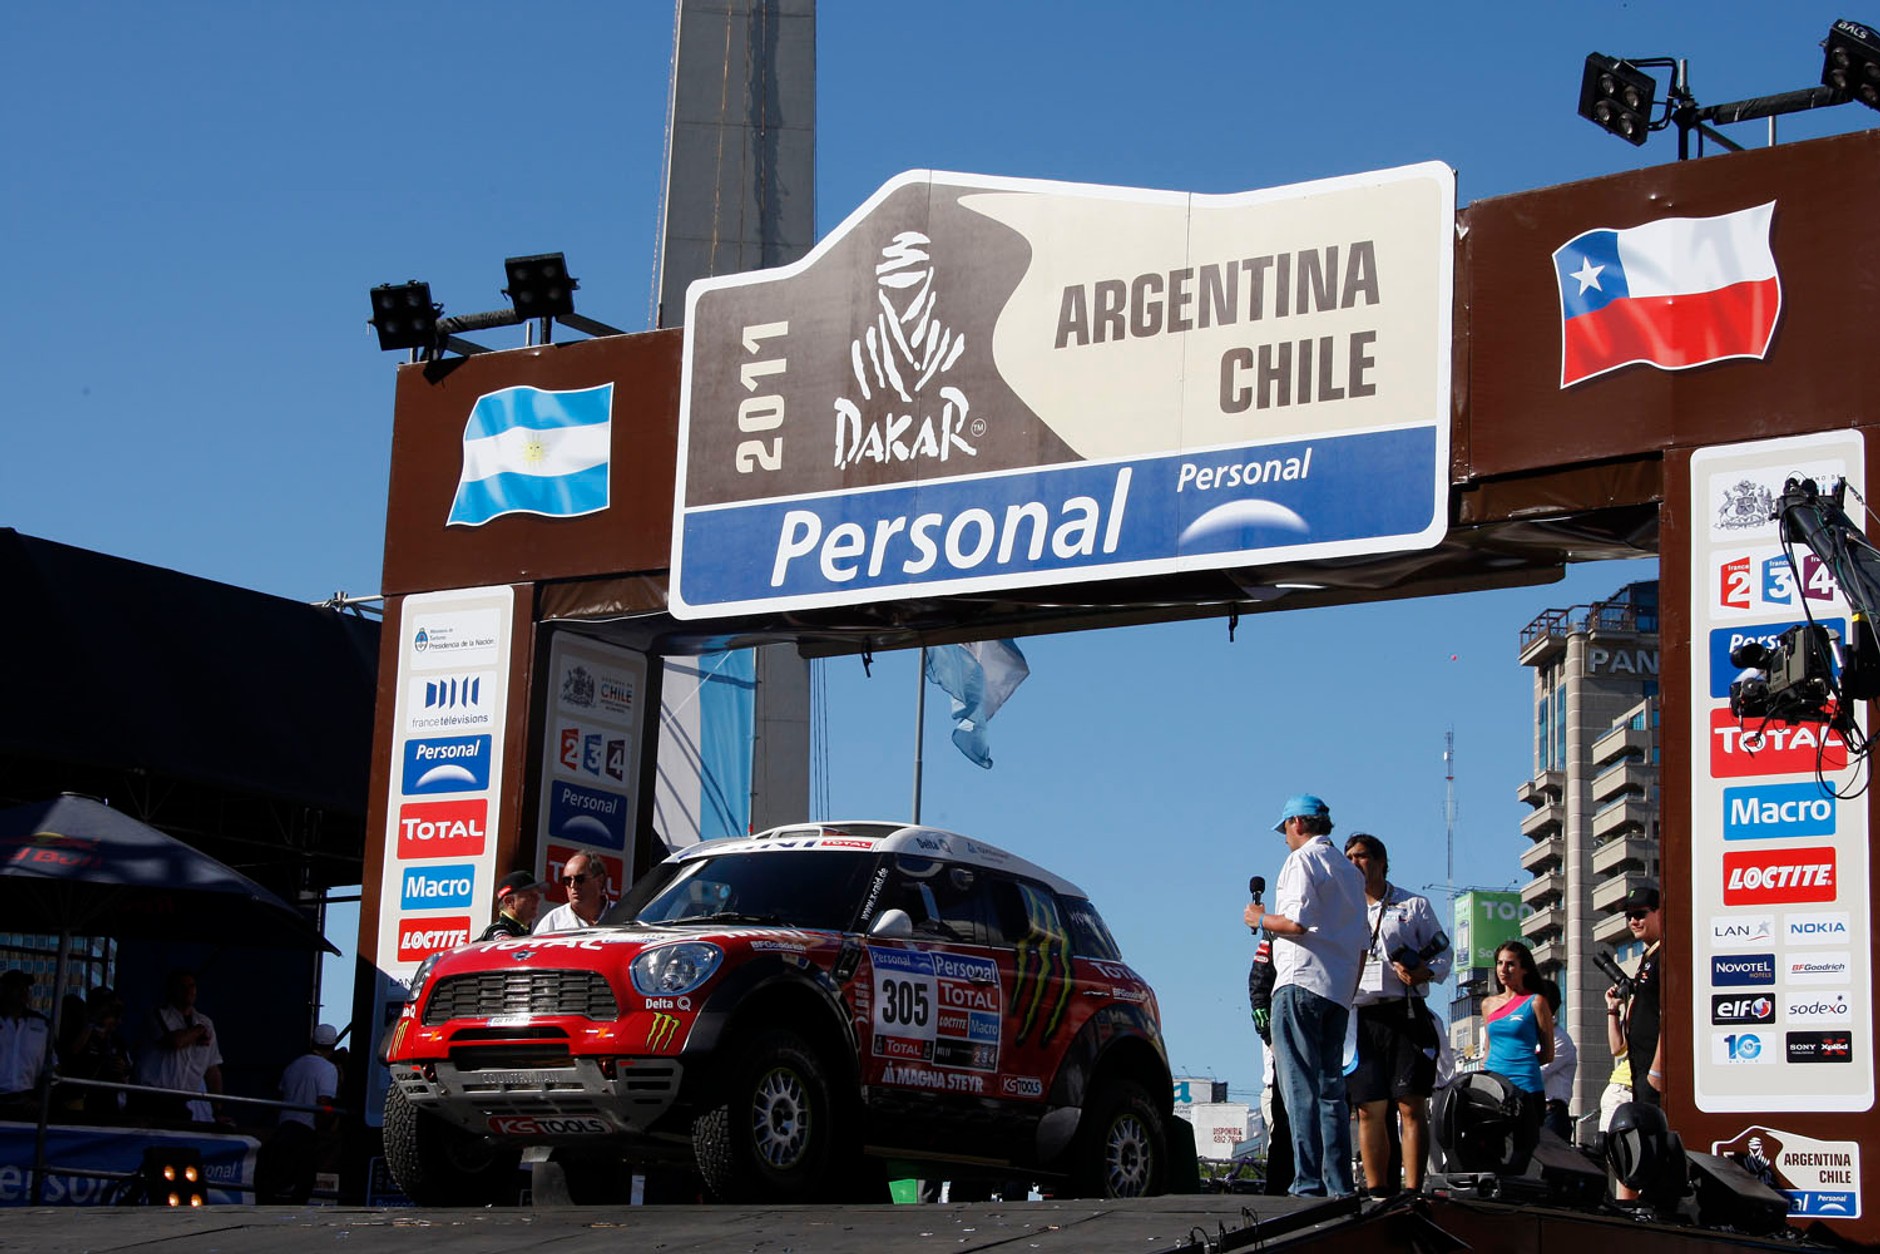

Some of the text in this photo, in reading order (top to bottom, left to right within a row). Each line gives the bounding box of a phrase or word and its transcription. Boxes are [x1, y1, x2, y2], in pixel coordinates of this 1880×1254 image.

[1054, 239, 1381, 349] ARGENTINA
[1219, 330, 1377, 414] CHILE
[735, 319, 790, 473] 2011
[834, 386, 978, 468] DAKAR
[1176, 447, 1312, 492] Personal
[771, 466, 1133, 588] Personal
[1727, 562, 1839, 603] 2 3 4
[600, 683, 632, 704] CHILE
[416, 739, 480, 760] Personal
[1714, 726, 1844, 753] TOTAL
[562, 788, 618, 815] Personal
[1731, 798, 1831, 825] Macro
[402, 818, 483, 840] TOTAL
[916, 838, 938, 850] Delta
[405, 876, 471, 898] Macro
[1728, 864, 1832, 890] LOCTITE
[860, 867, 888, 921] www.x-raid.de
[1715, 926, 1749, 937] LAN
[1790, 922, 1846, 934] NOKIA
[401, 930, 468, 950] LOCTITE
[873, 952, 911, 966] Personal
[935, 956, 996, 981] Personal
[1716, 961, 1771, 973] NOVOTEL
[1791, 963, 1845, 974] BFGoodrich
[645, 997, 674, 1009] Delta
[882, 978, 929, 1027] 305
[940, 981, 998, 1009] TOTAL
[1717, 1000, 1751, 1017] elf
[1789, 1001, 1848, 1015] sodexo
[939, 1015, 998, 1036] LOCTITE Macro
[886, 1039, 922, 1056] TOTAL
[895, 1067, 984, 1093] MAGNA STEYR
[1784, 1153, 1851, 1166] ARGENTINA
[1819, 1170, 1851, 1184] CHILE
[1817, 1194, 1848, 1202] Personal
